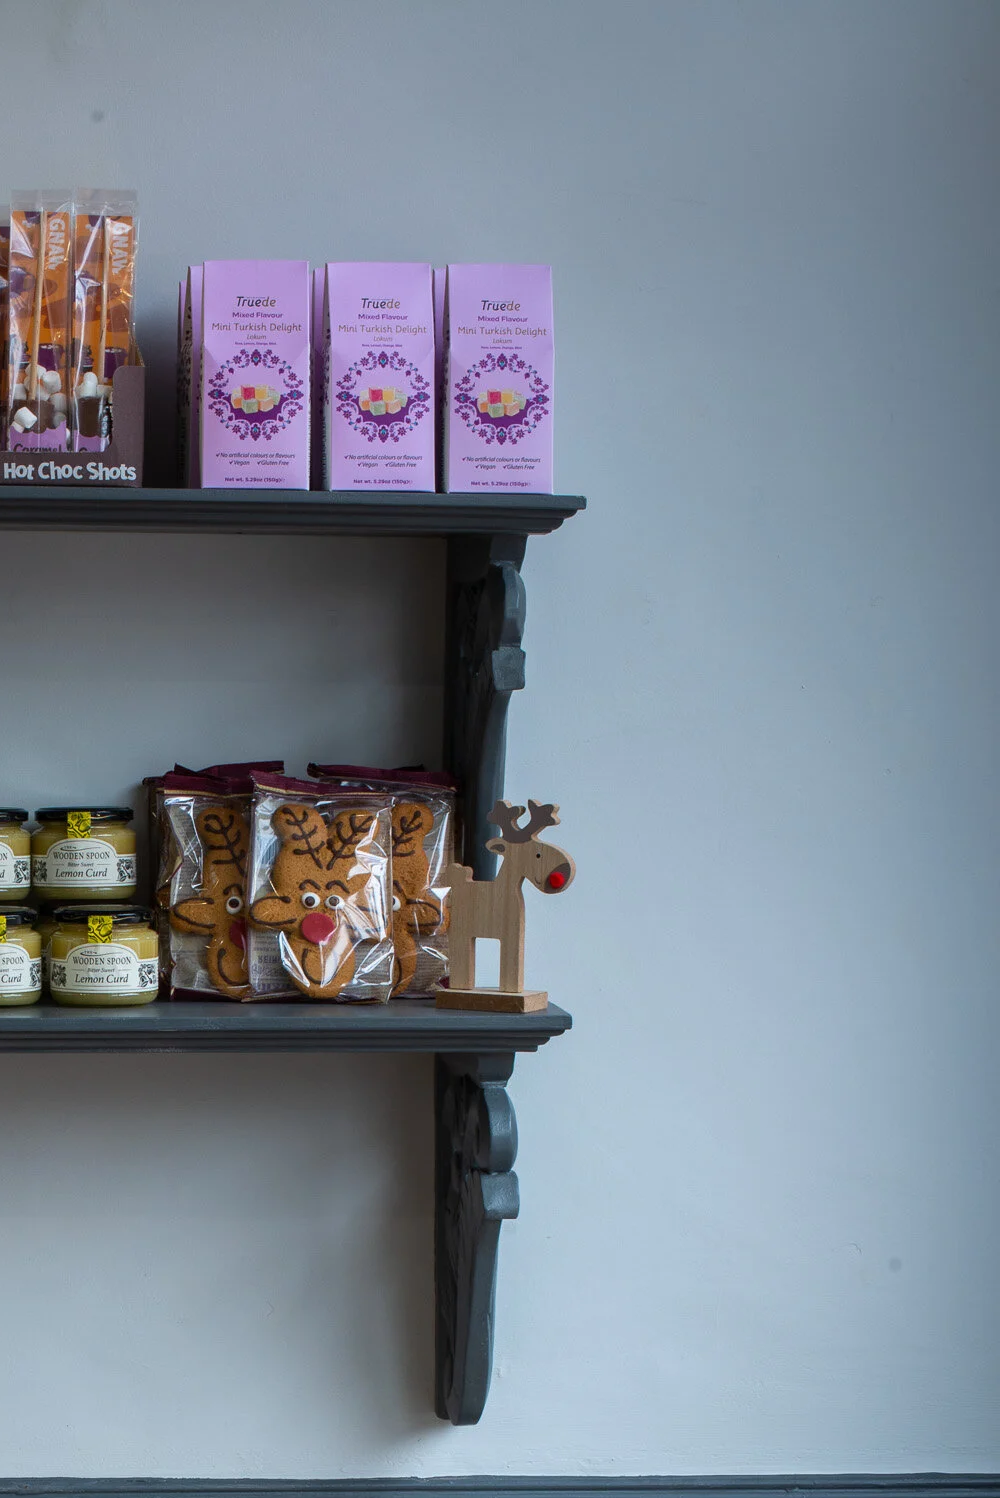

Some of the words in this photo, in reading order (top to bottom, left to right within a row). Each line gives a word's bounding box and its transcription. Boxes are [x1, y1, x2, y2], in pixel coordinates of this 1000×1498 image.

[47, 218, 65, 270] GNAW
[112, 223, 128, 273] GNAW
[237, 296, 276, 307] Truede
[361, 298, 400, 309] Truede
[481, 300, 520, 311] Truede
[234, 323, 266, 331] Turkish
[267, 324, 302, 333] Delight
[480, 327, 512, 335] Turkish
[515, 328, 547, 337] Delight
[4, 462, 34, 479] Hot
[38, 463, 83, 479] Choc
[87, 463, 136, 480] Shots
[55, 868, 84, 877] Lemon
[86, 868, 107, 877] Curd
[1, 957, 24, 965] SPOON
[73, 957, 105, 965] WOODEN
[107, 957, 132, 965] SPOON
[1, 974, 22, 983] Curd
[75, 974, 105, 983] Lemon
[106, 974, 128, 983] Curd
